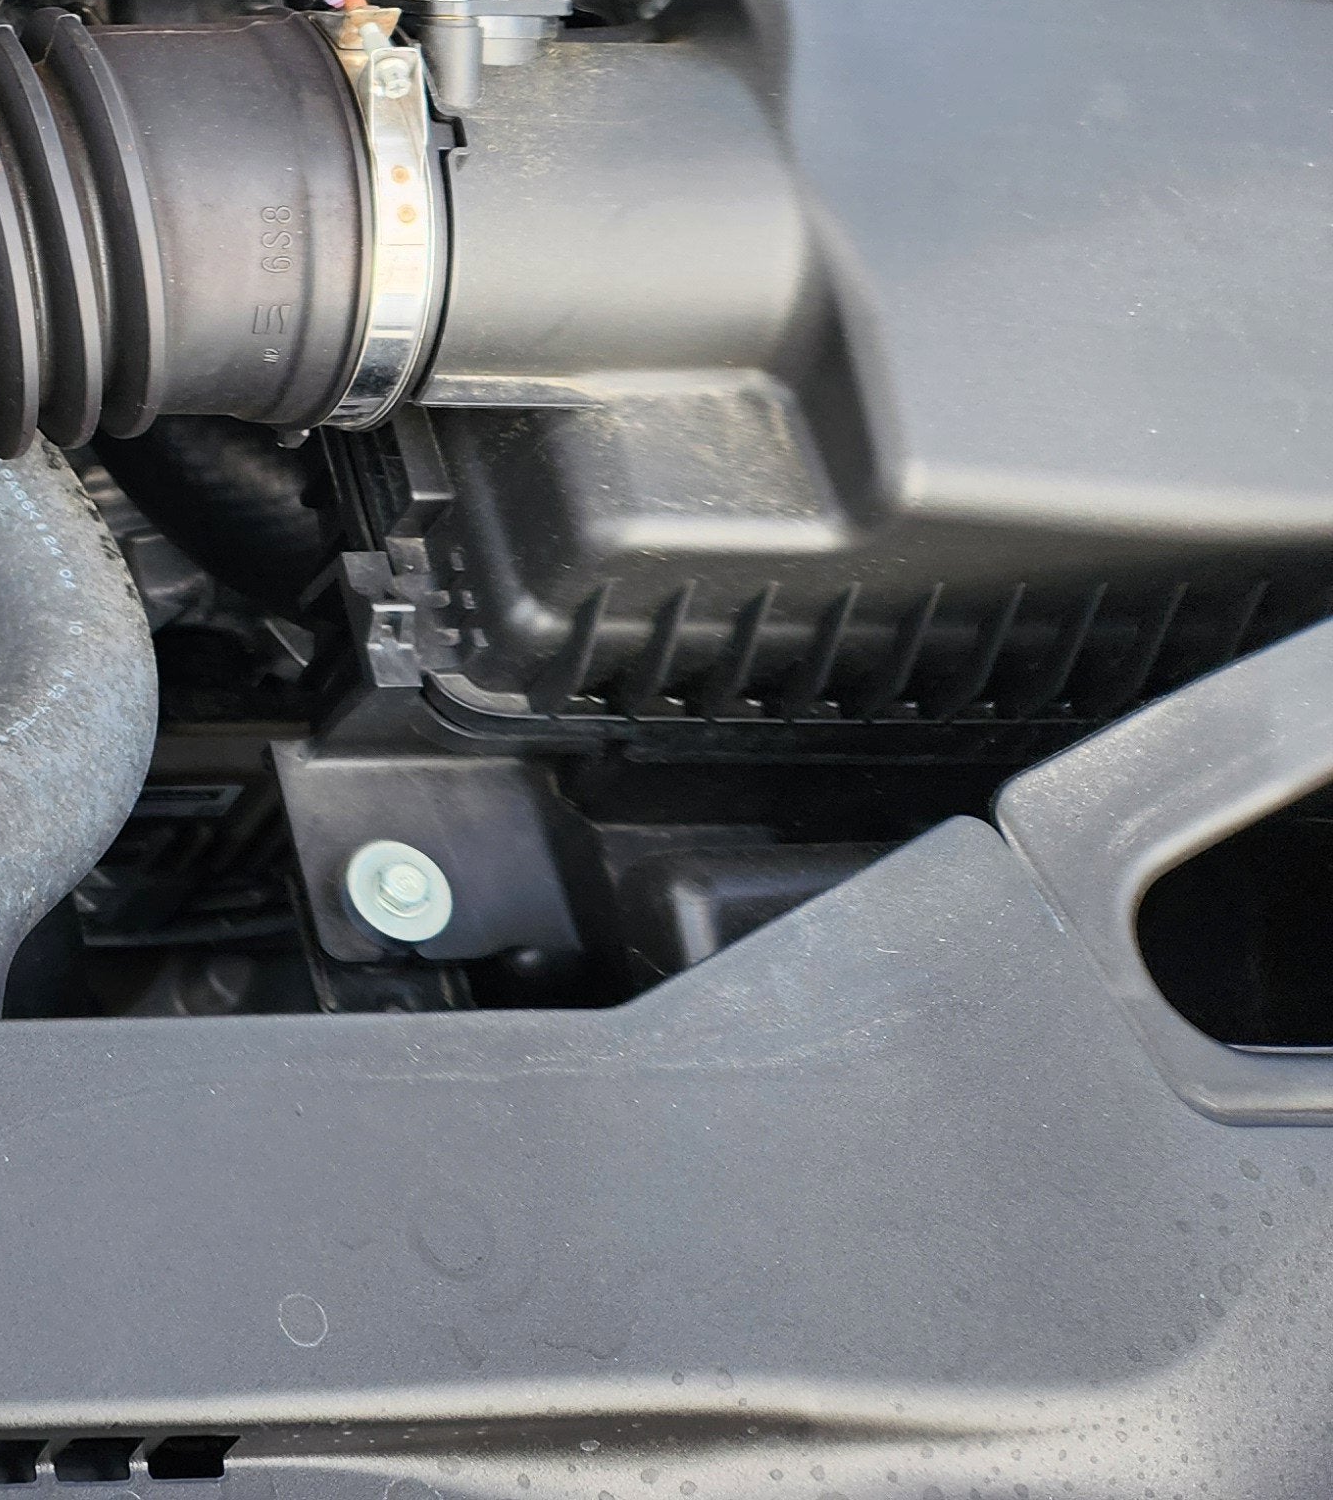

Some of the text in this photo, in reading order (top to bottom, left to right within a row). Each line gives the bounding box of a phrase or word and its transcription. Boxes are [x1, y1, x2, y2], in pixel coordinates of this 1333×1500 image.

[260, 204, 294, 274] 6S8
[41, 534, 64, 559] 24
[58, 568, 77, 591] 04
